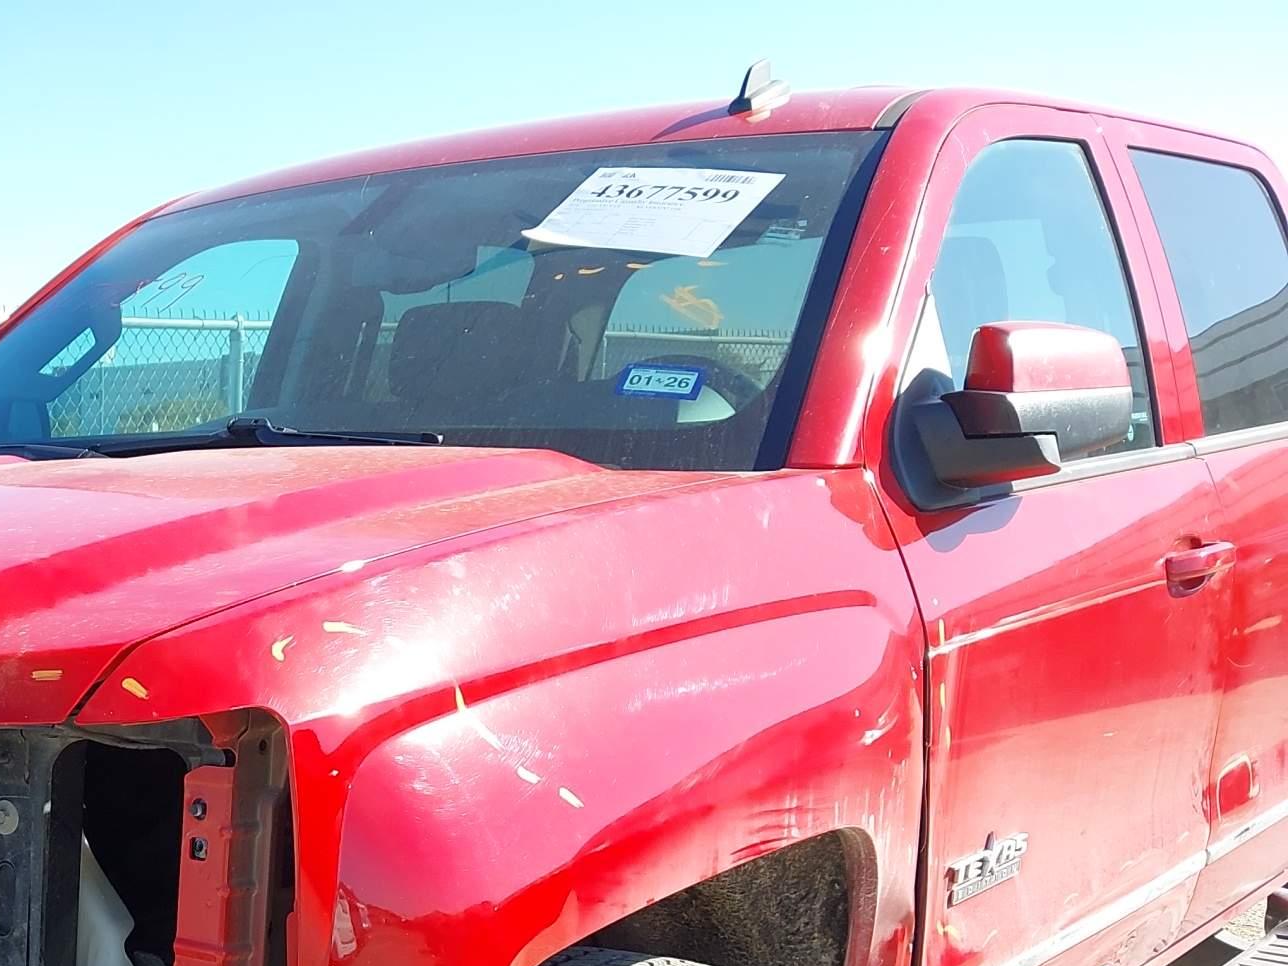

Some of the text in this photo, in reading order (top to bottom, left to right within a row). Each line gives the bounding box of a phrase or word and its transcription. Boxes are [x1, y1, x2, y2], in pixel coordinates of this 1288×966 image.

[592, 184, 741, 204] 43677599
[629, 374, 691, 389] 01 26
[949, 831, 1029, 886] TEXAS
